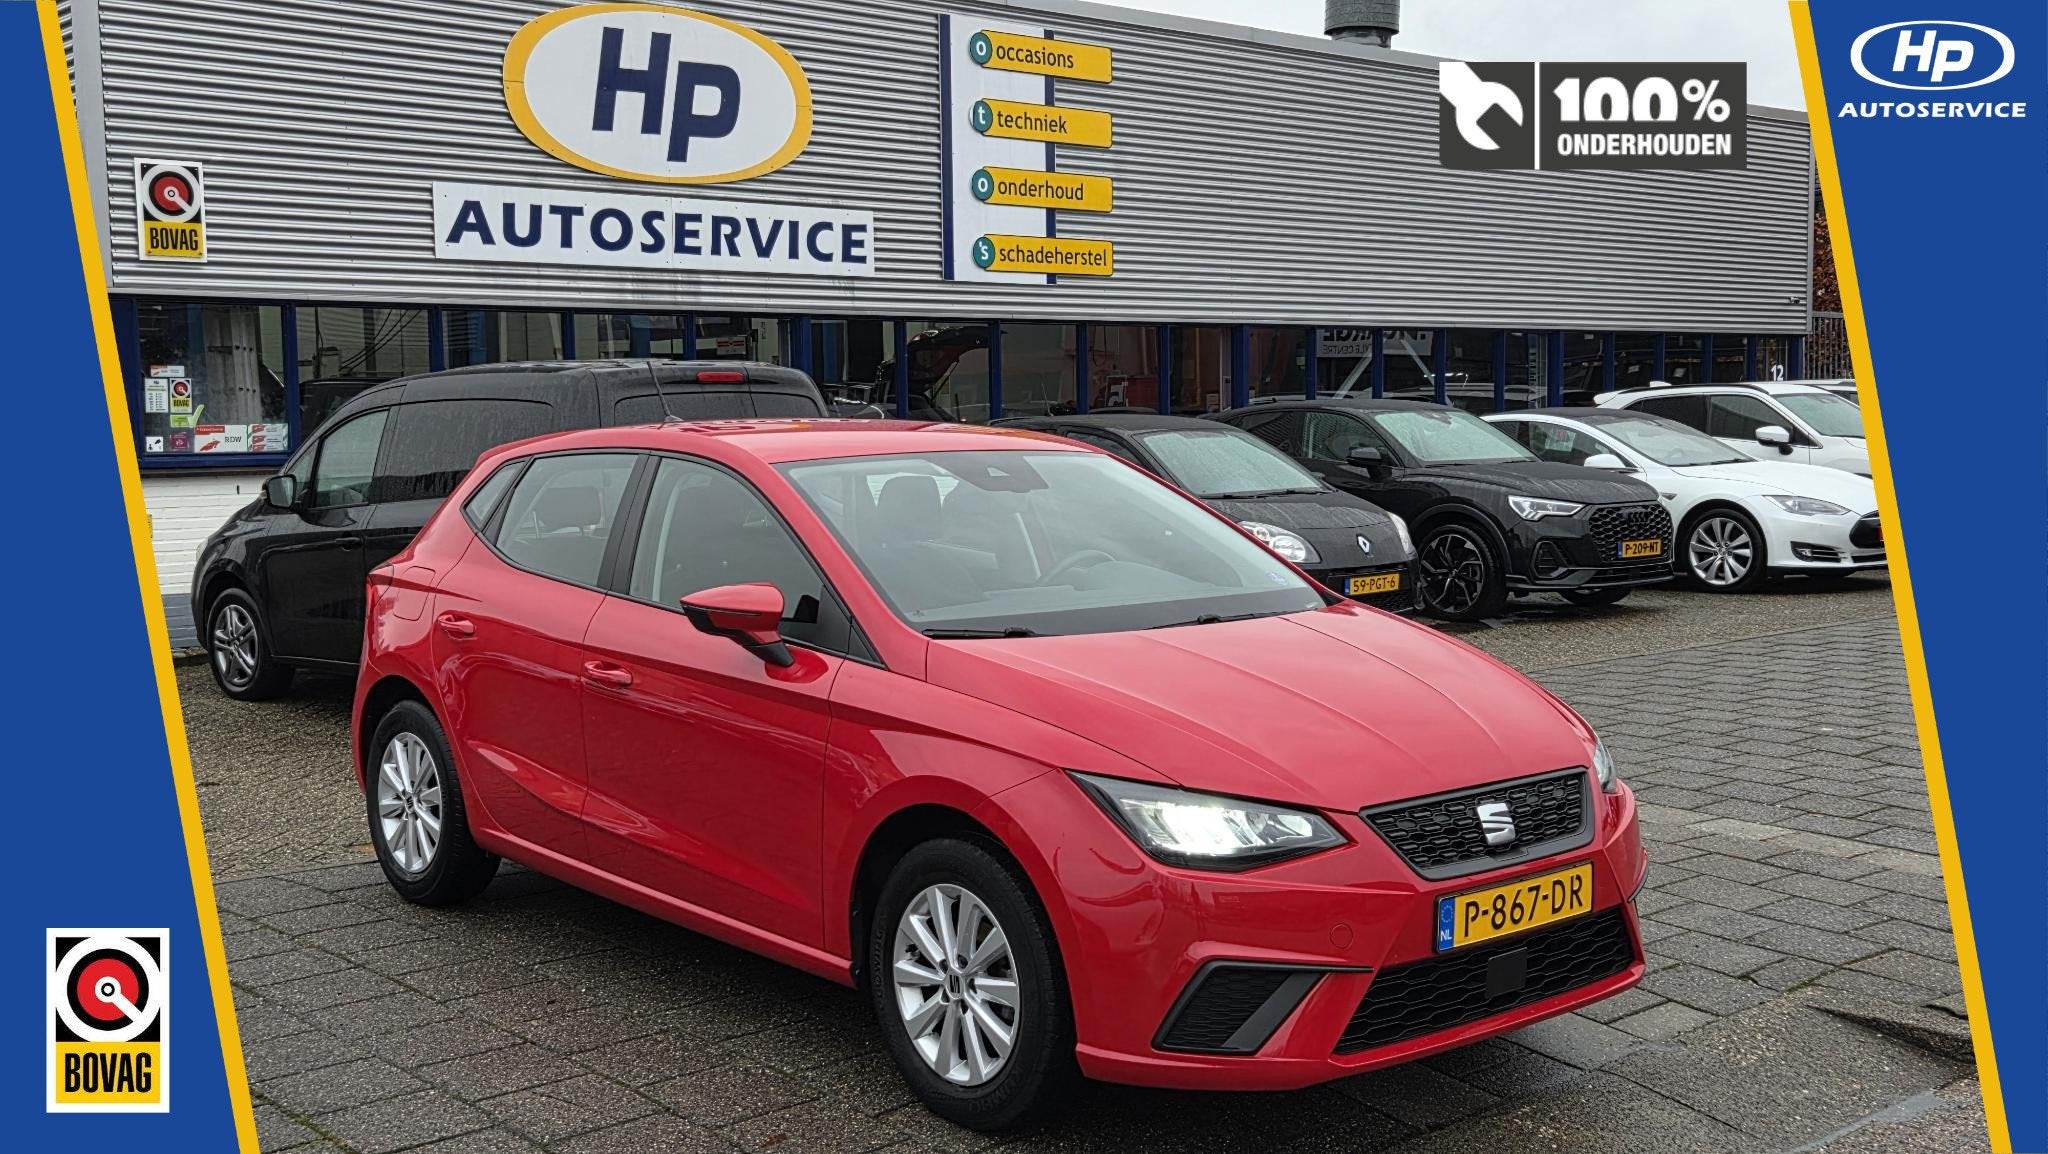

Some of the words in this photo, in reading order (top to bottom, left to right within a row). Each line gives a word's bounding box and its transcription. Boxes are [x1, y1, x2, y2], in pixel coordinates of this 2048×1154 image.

[996, 45, 1074, 69] occasions
[592, 26, 741, 163] Hp
[997, 110, 1068, 134] techniek
[998, 178, 1084, 201] onderhoud
[149, 227, 199, 251] BOVAG
[445, 199, 868, 265] AUTOSERVICE
[1000, 244, 1107, 267] schadeherstel
[1771, 364, 1784, 382] 12
[1625, 541, 1659, 556] P-209-NT
[1353, 576, 1396, 593] 59-PGT-6
[1440, 929, 1453, 942] NL
[1464, 873, 1584, 938] P-867-DR
